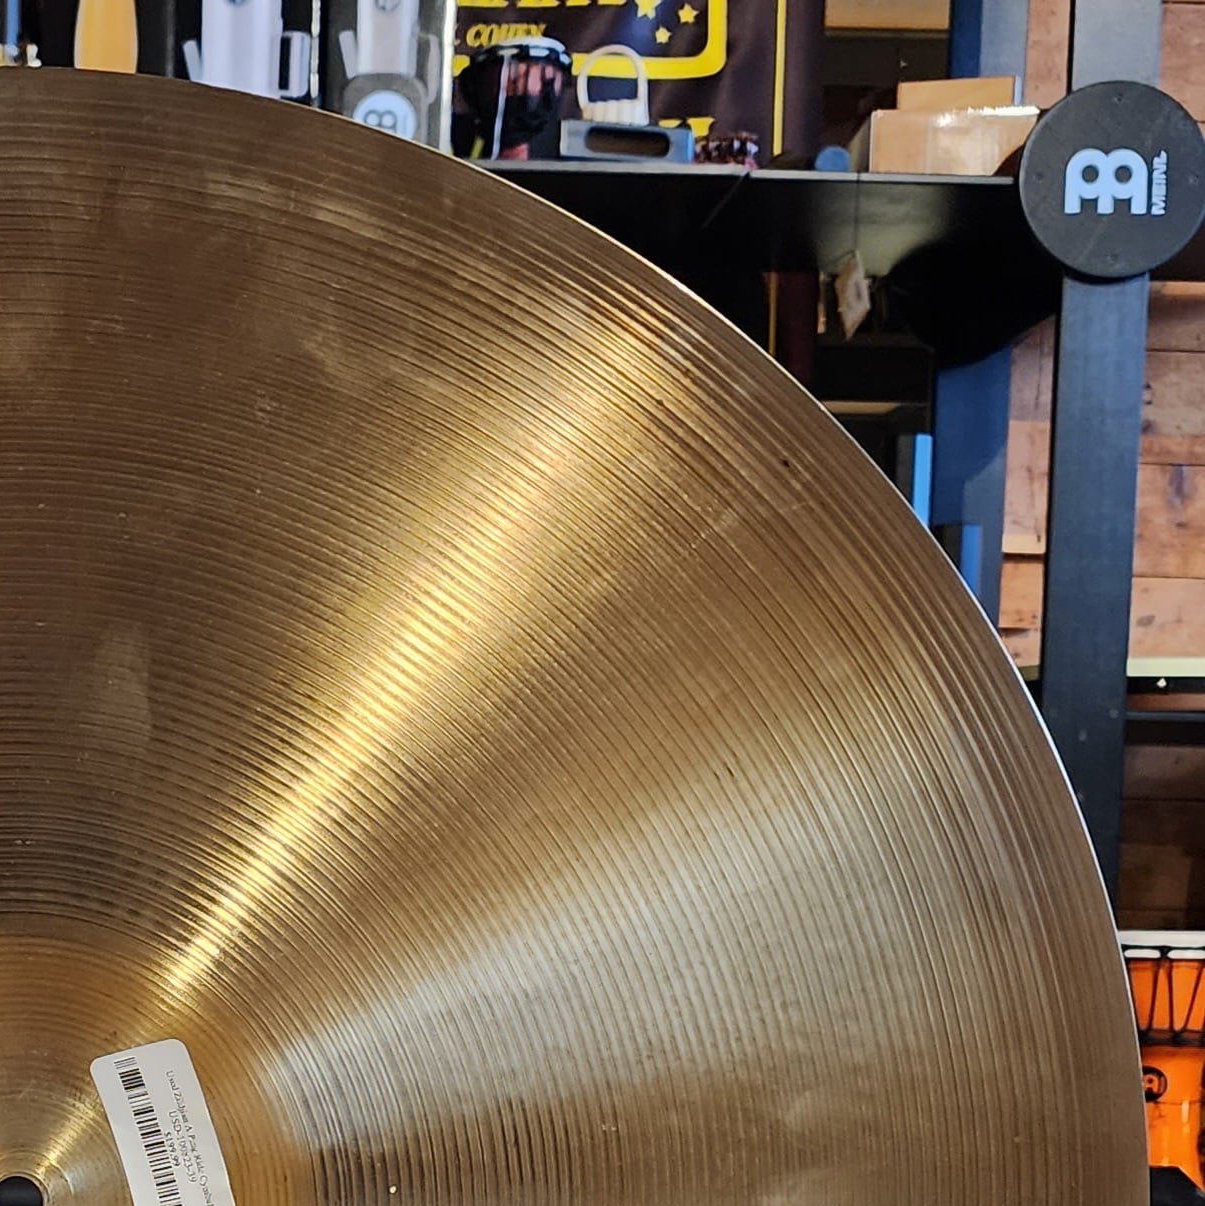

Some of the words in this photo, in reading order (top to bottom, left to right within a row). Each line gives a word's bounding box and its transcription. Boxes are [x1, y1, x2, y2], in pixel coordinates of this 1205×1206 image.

[1151, 149, 1168, 215] MEINL
[184, 1123, 193, 1132] A
[163, 1131, 180, 1166] $199.99
